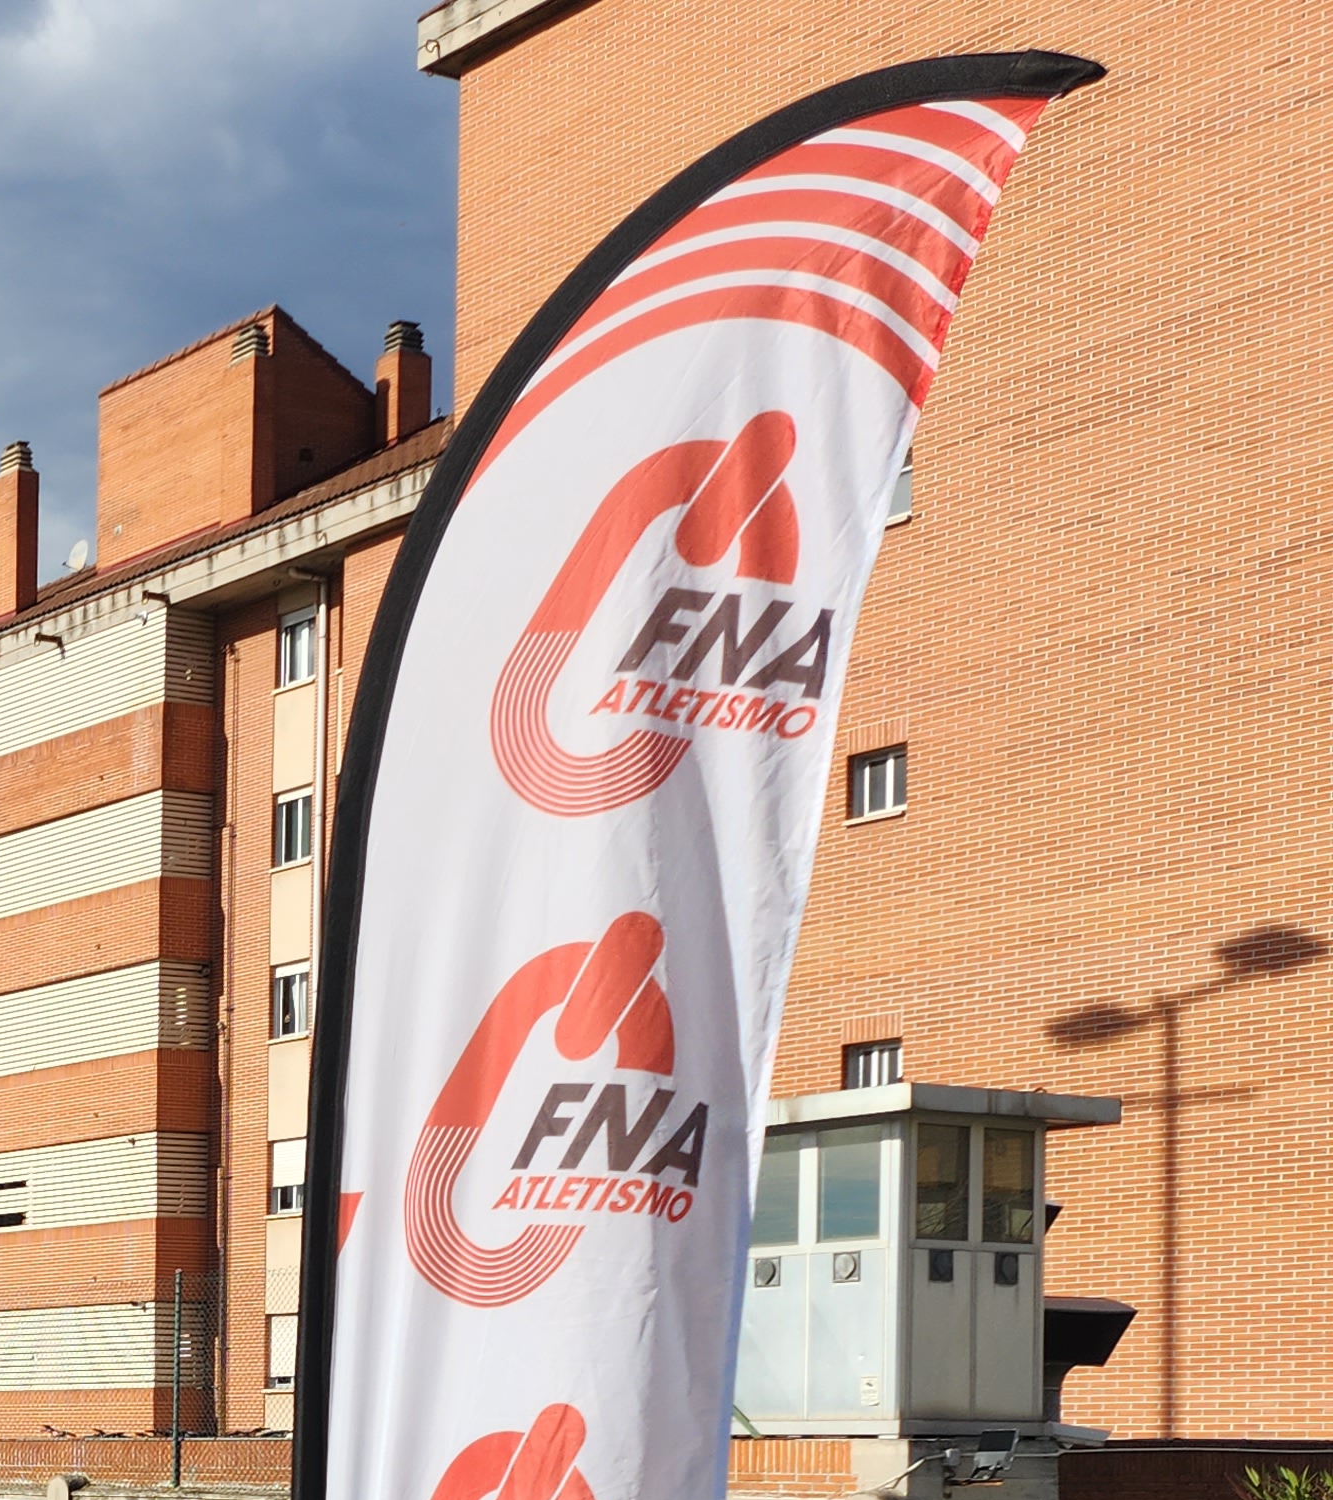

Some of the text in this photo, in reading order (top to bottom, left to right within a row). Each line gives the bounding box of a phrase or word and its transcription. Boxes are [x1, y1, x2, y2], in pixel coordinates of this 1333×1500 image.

[614, 587, 835, 699] FNA
[588, 679, 817, 738] ATLETISMO
[511, 1083, 709, 1188] FNA
[491, 1176, 693, 1224] ATLETISMO
